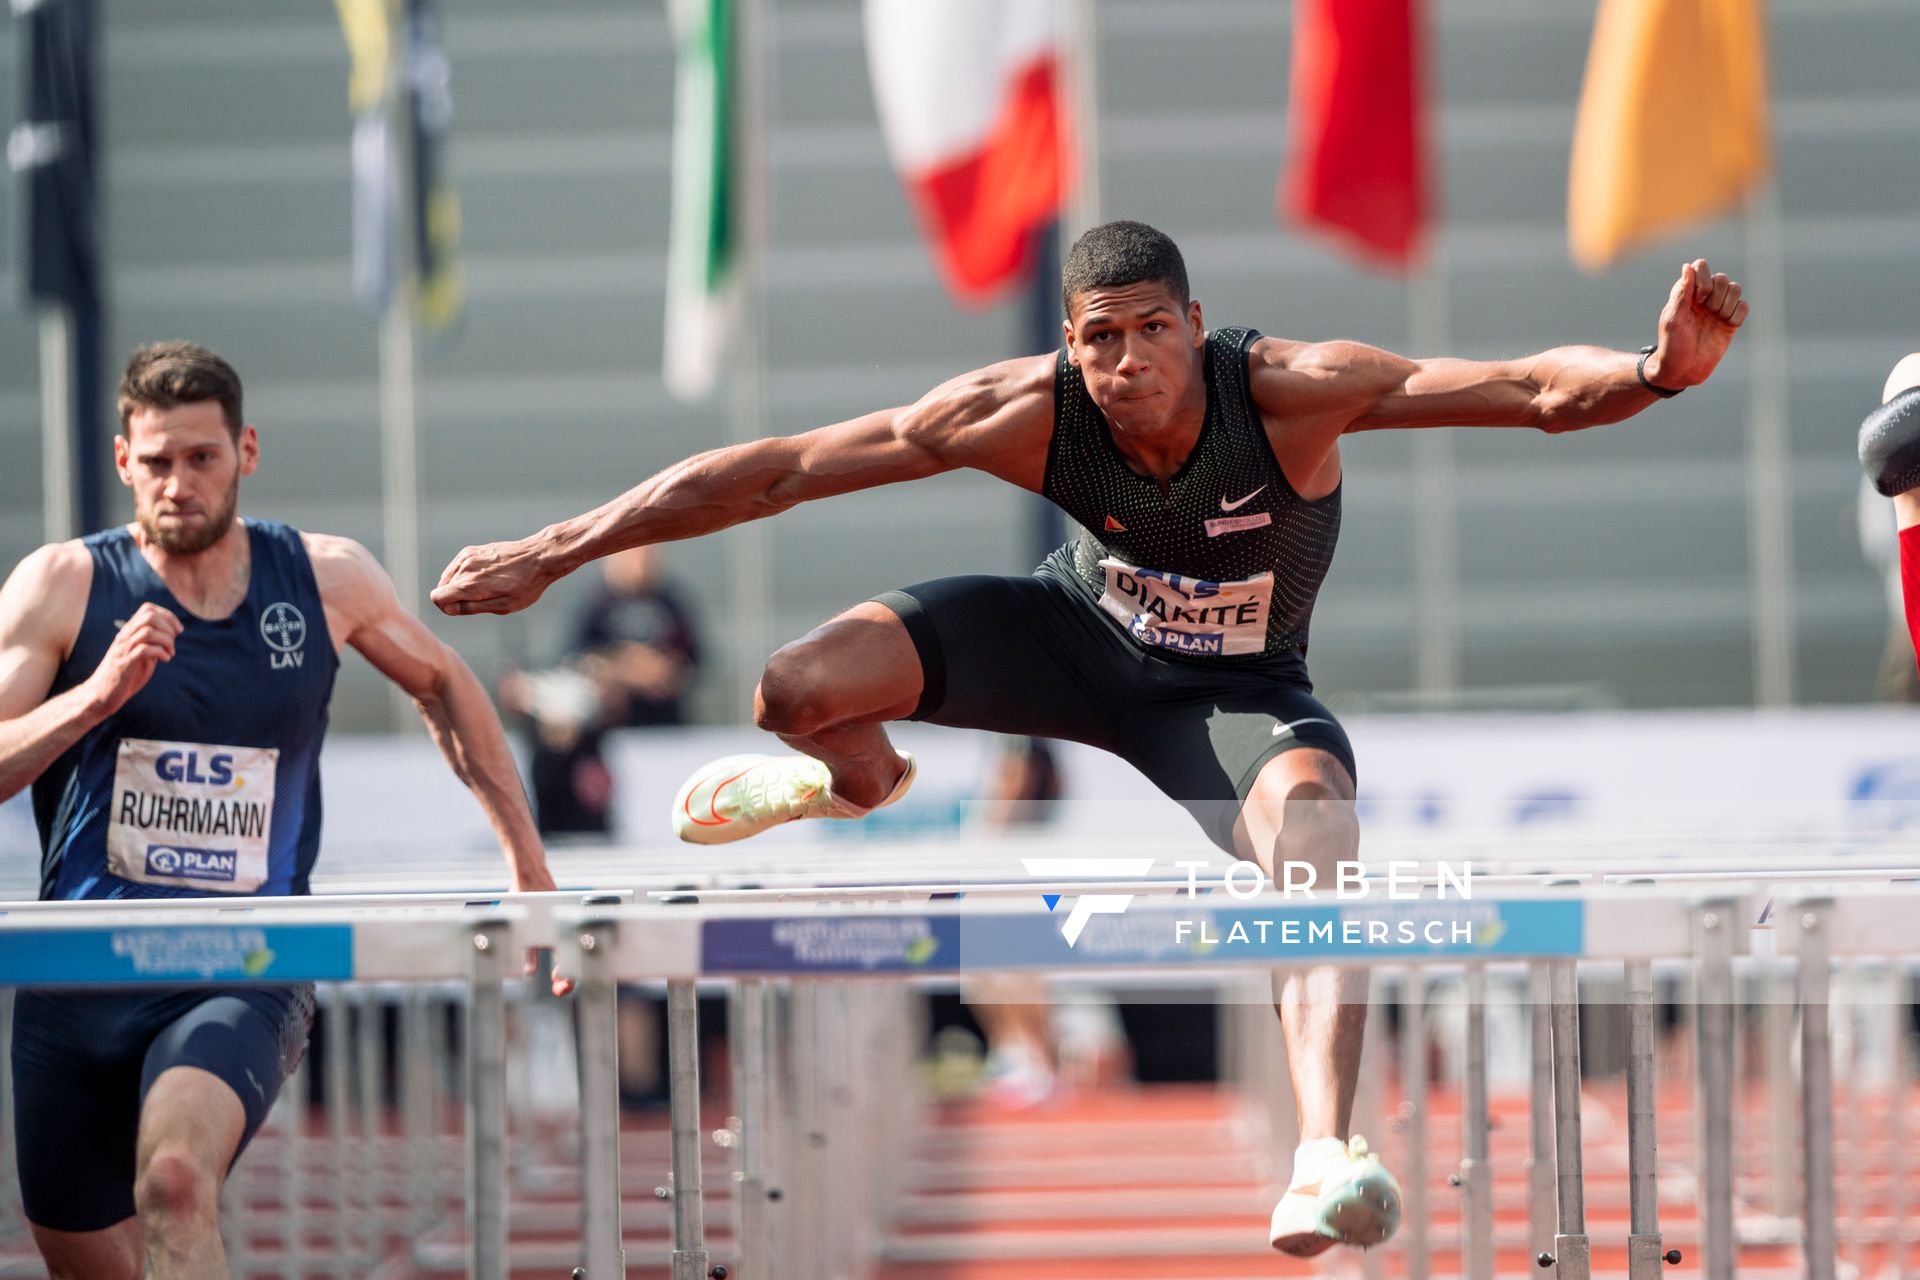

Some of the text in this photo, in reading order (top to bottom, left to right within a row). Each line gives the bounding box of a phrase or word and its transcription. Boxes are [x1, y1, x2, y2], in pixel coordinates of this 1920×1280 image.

[1116, 571, 1260, 626] DIAKITÉ
[1165, 631, 1219, 653] PLAN
[270, 651, 305, 669] LAV
[119, 789, 267, 838] RUHRMANN
[183, 852, 234, 871] PLAN
